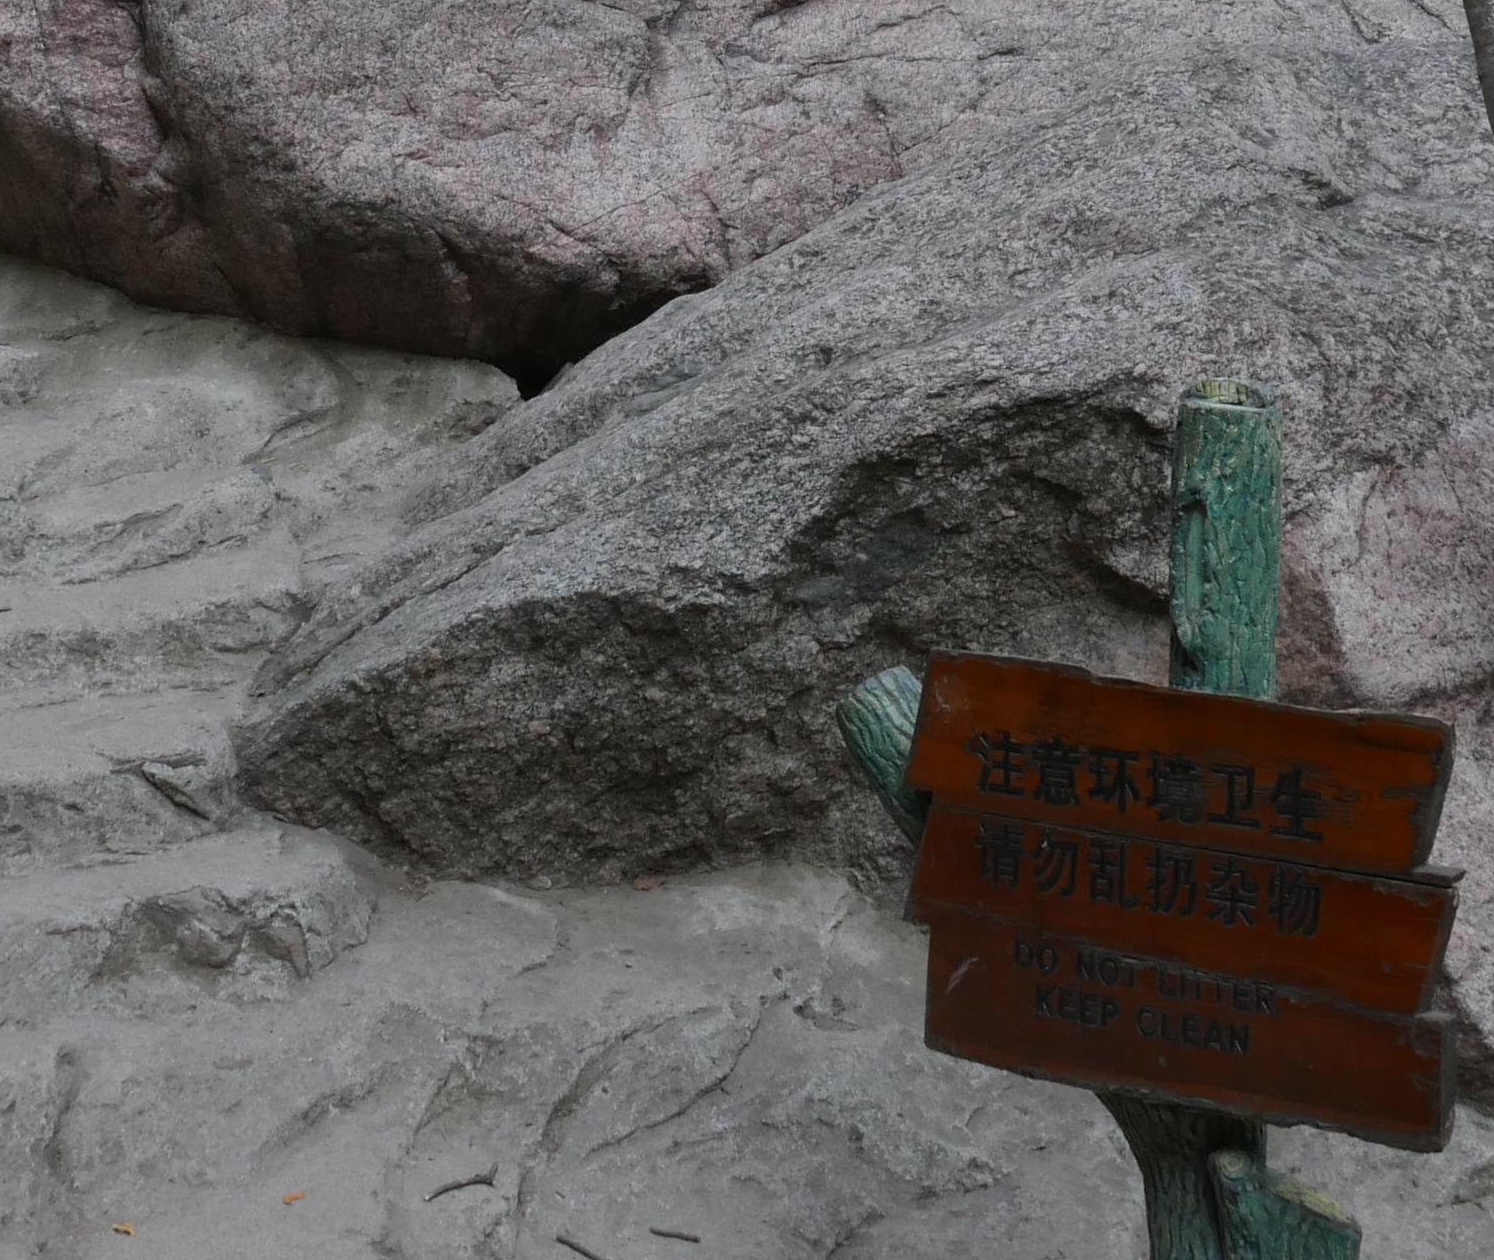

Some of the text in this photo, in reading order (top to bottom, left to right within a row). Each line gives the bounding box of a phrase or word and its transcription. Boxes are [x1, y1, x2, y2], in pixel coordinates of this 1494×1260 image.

[969, 731, 1324, 843] 注意环境卫生
[976, 822, 1321, 938] 请勿乱扔杂物
[1015, 938, 1277, 1015] DO NOT LITTER
[1035, 985, 1251, 1055] KEEP CLEAN
